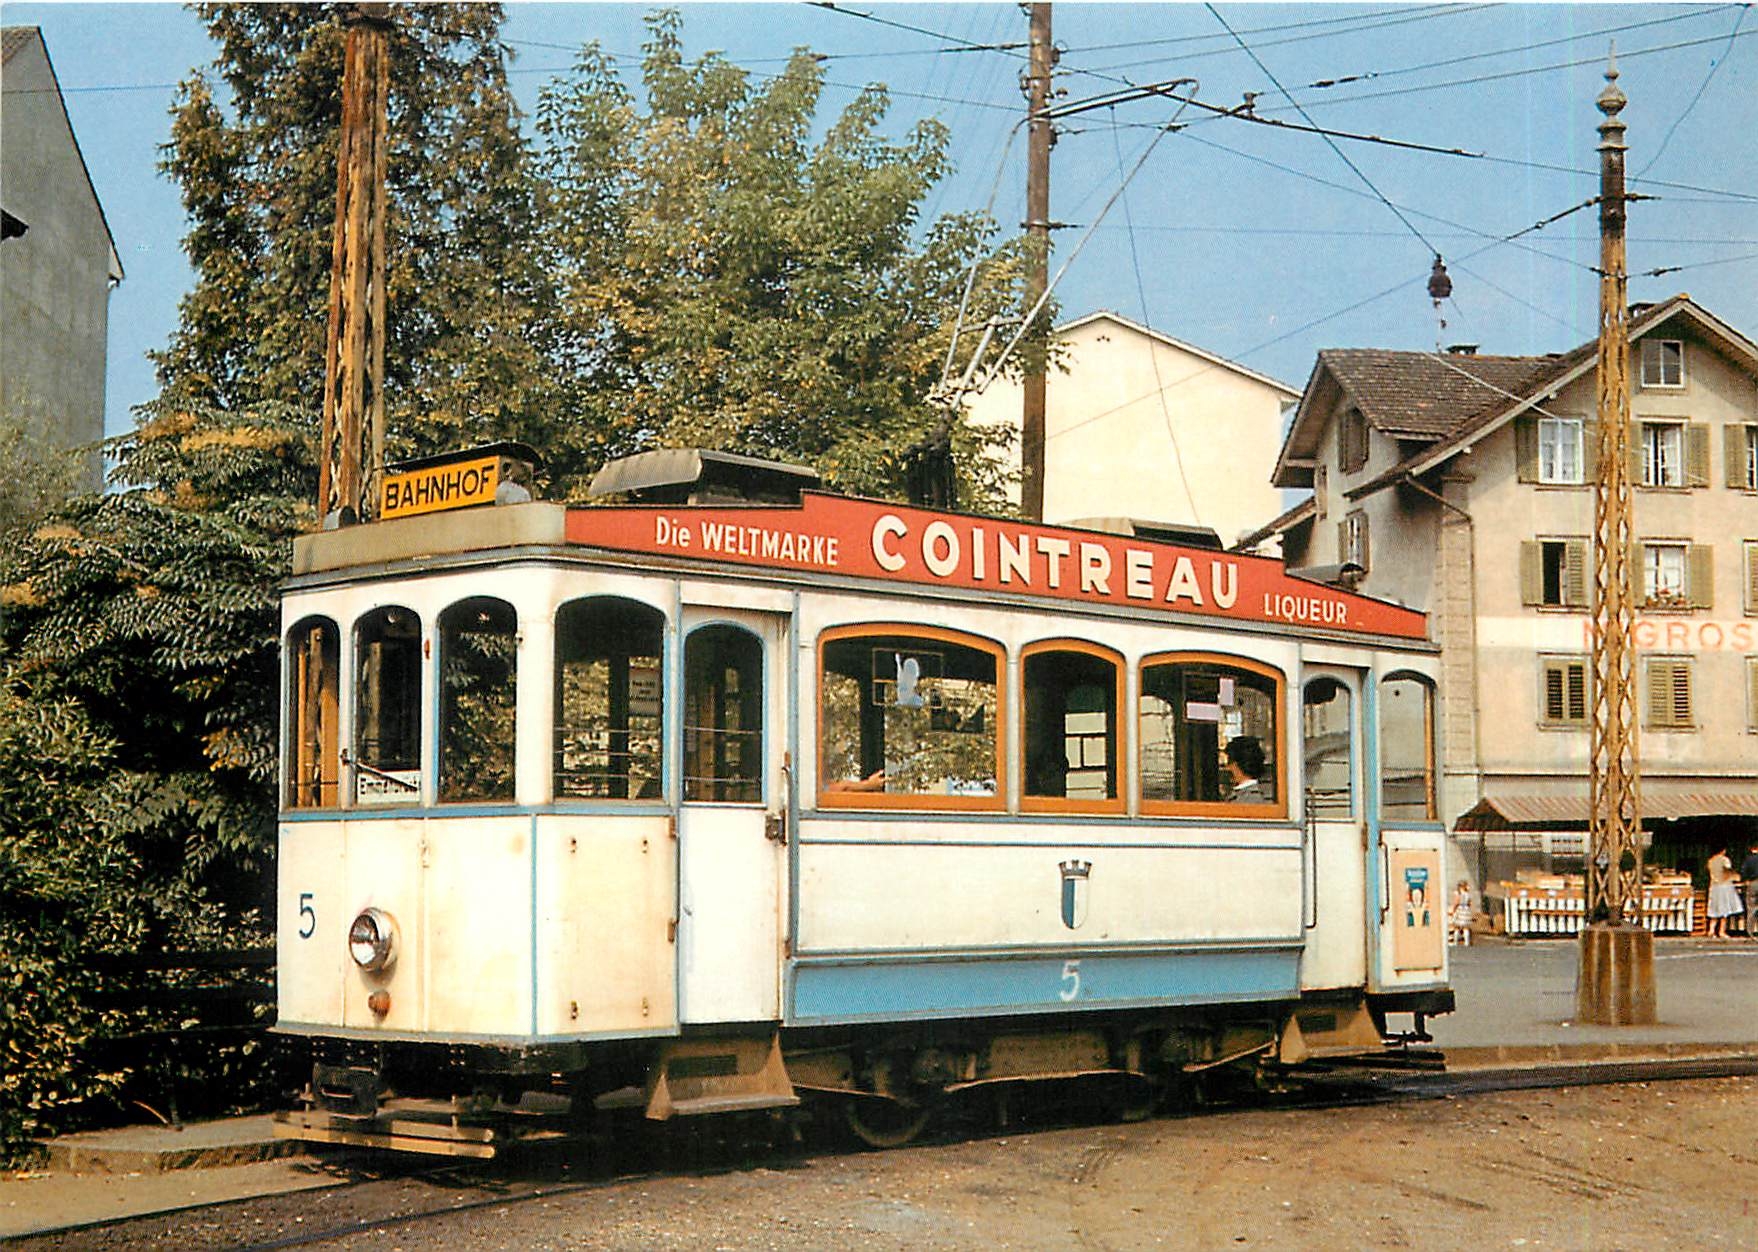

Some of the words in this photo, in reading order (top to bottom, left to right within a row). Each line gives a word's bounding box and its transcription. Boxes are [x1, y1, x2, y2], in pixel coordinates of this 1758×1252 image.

[385, 464, 495, 511] BAHNHOF
[655, 516, 691, 547] Die
[701, 521, 839, 566] WELTMARKE
[871, 514, 1239, 610] COINTREAU
[1264, 592, 1348, 624] LIQUEUR
[1582, 620, 1755, 651] MGROS
[298, 892, 316, 940] 5
[1059, 959, 1082, 1002] 5
